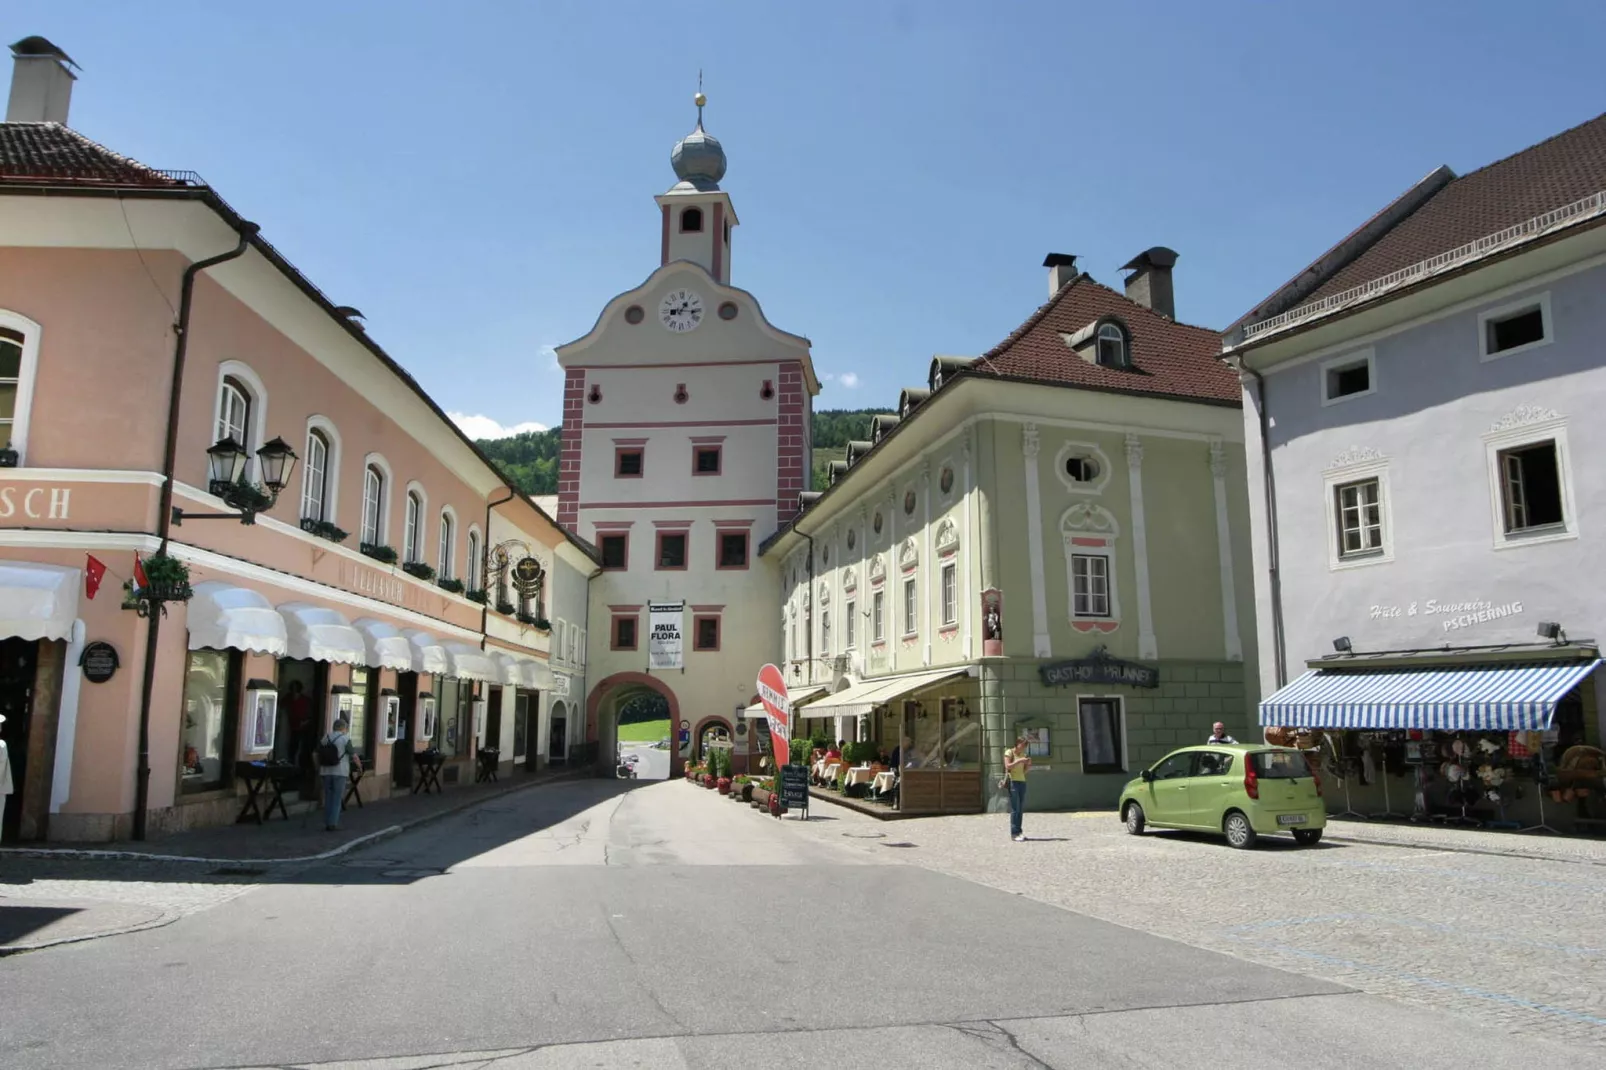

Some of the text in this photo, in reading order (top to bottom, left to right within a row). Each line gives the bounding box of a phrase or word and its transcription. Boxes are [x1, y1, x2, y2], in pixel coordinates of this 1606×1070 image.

[1407, 602, 1418, 616] &
[1424, 598, 1493, 615] Souvenirs
[1442, 601, 1524, 632] PSCHERNIG
[651, 632, 681, 640] FLORA
